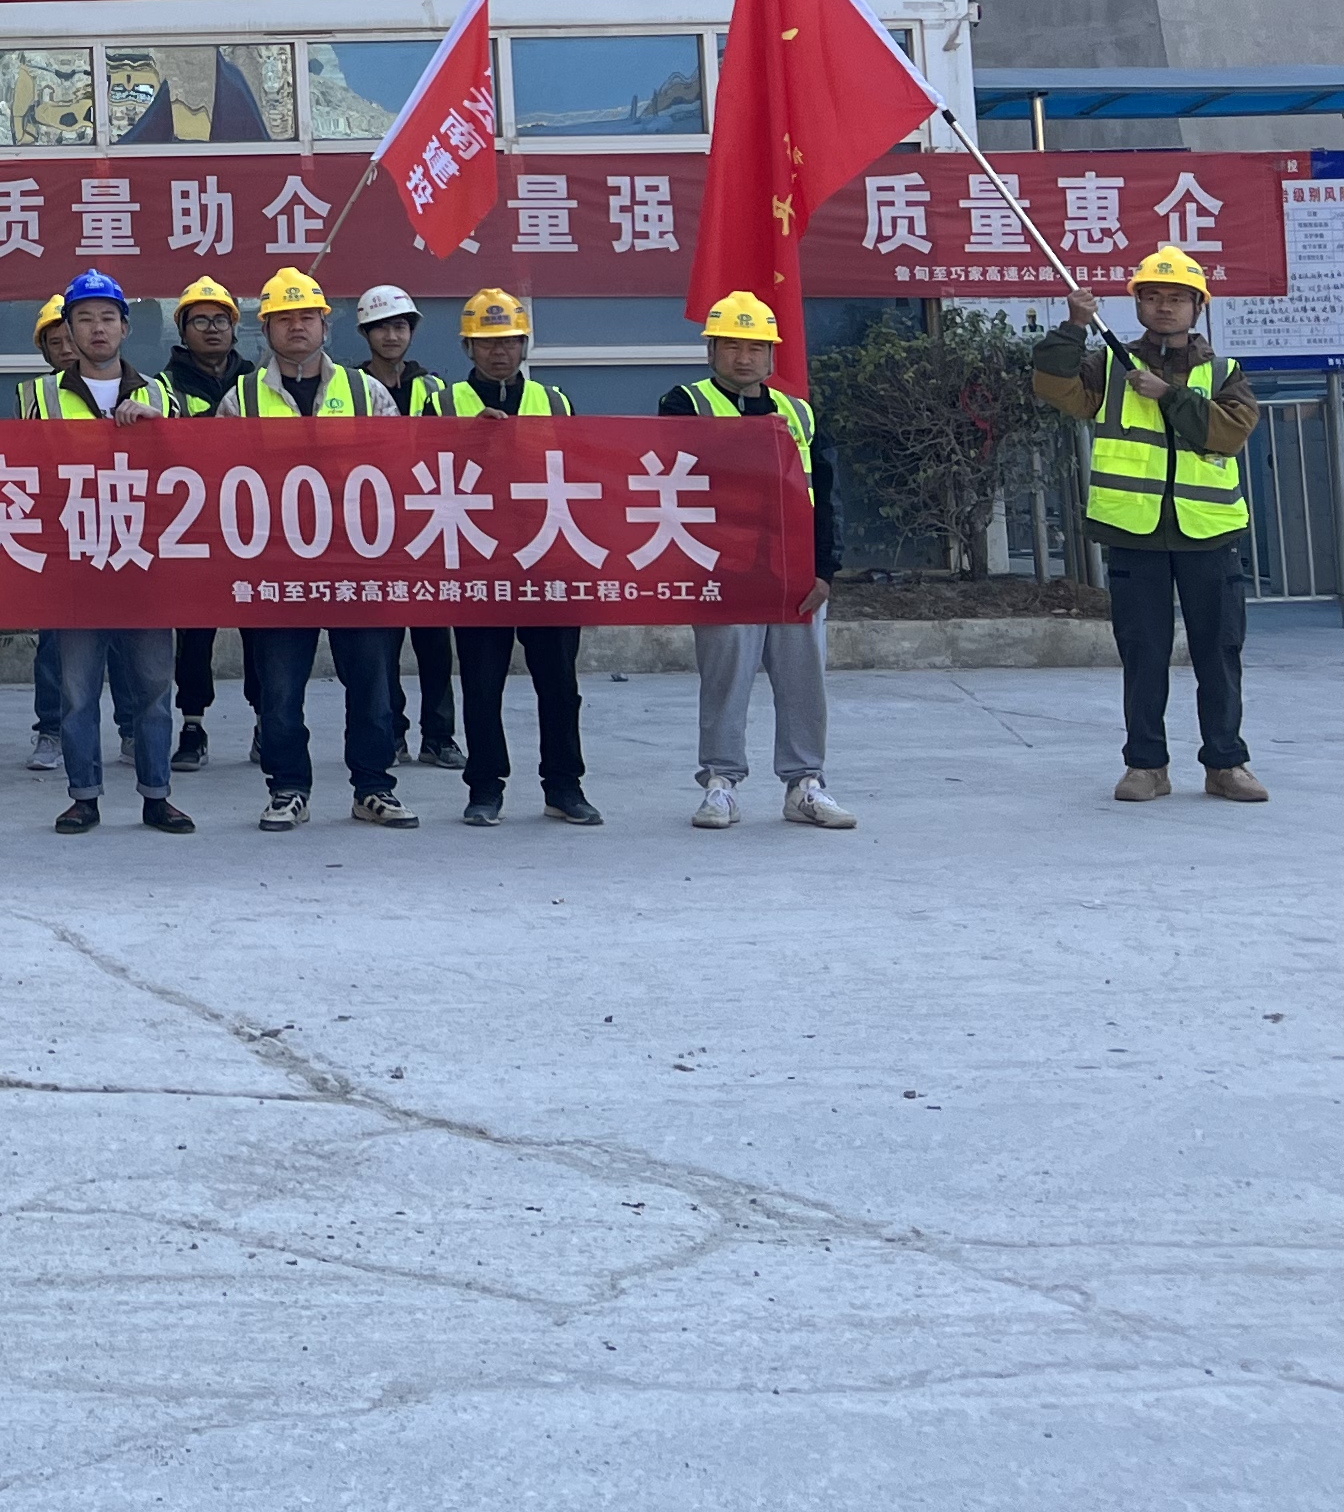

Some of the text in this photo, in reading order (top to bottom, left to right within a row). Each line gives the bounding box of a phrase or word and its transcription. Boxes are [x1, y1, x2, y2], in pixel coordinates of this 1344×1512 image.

[862, 169, 1225, 256] 质量惠企
[231, 578, 723, 604] 鲁甸至巧家高速公路项目土建工程6-5工点
